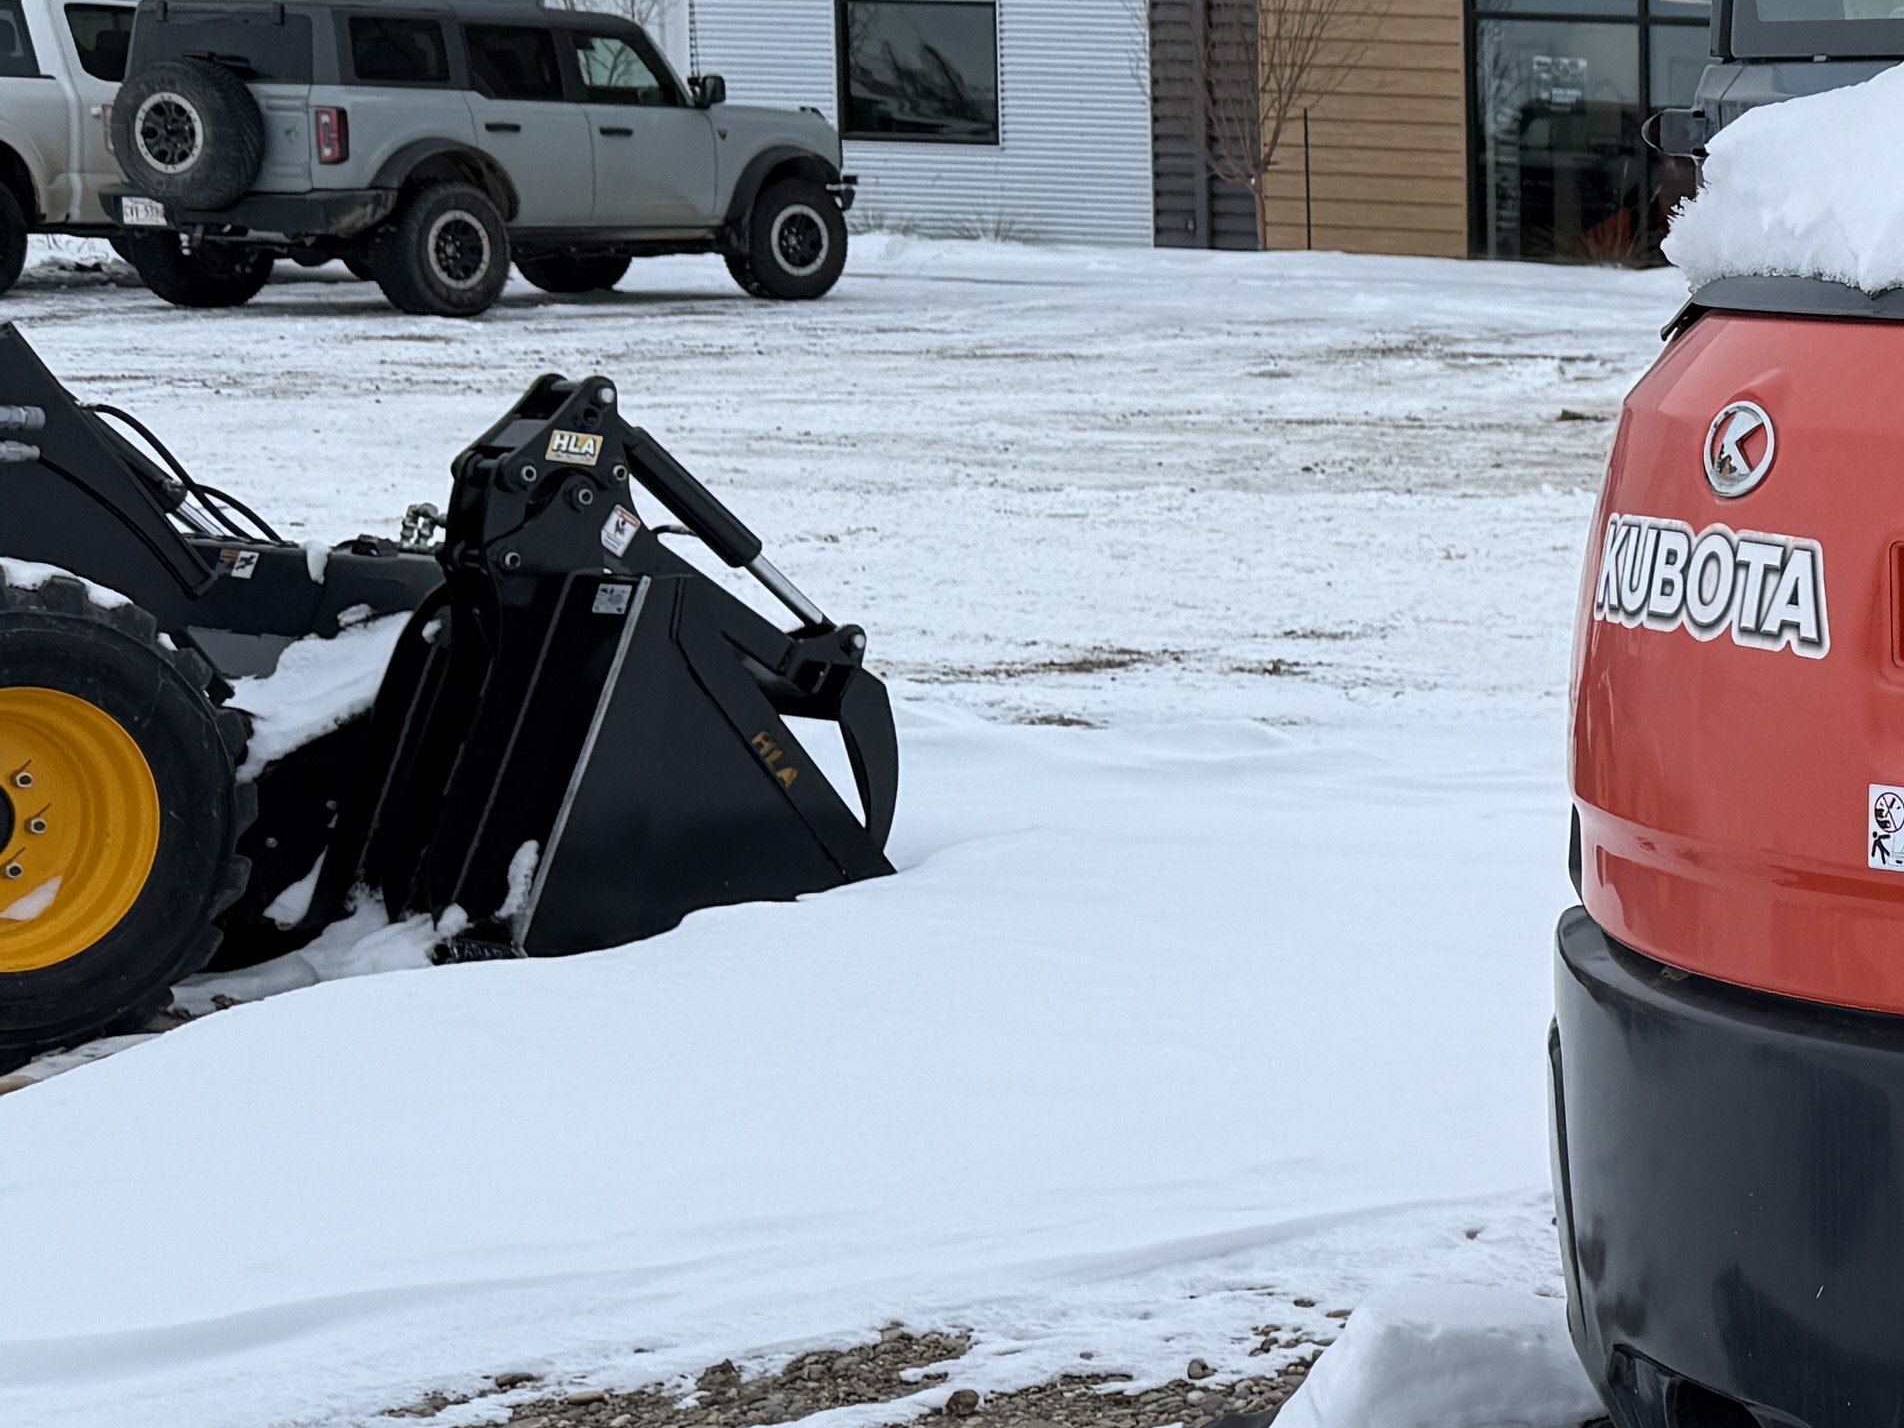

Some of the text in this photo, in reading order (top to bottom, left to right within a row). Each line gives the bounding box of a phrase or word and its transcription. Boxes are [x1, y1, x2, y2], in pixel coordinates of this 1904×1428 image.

[552, 432, 595, 456] HLA
[1596, 521, 1821, 643] KUBOTA
[751, 730, 798, 789] HLA
